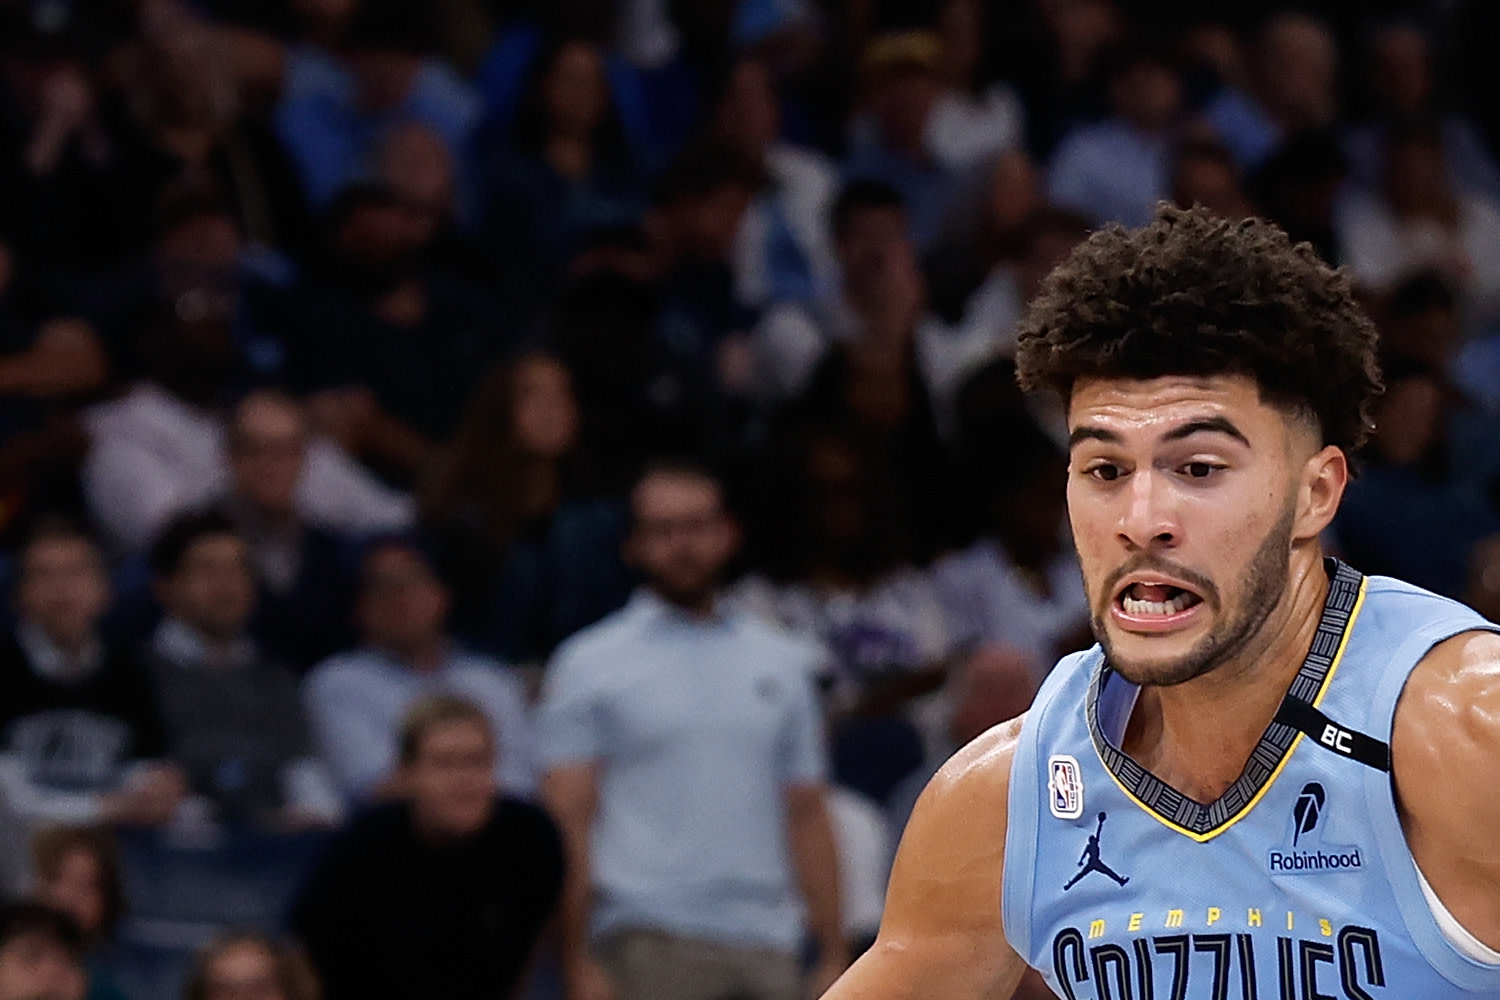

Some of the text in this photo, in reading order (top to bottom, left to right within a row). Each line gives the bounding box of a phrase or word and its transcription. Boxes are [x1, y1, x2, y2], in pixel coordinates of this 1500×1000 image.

[1320, 723, 1353, 754] BC
[1067, 765, 1075, 808] DEBUT
[1270, 849, 1361, 870] Robinhood
[1088, 906, 1333, 939] MEMPHIS
